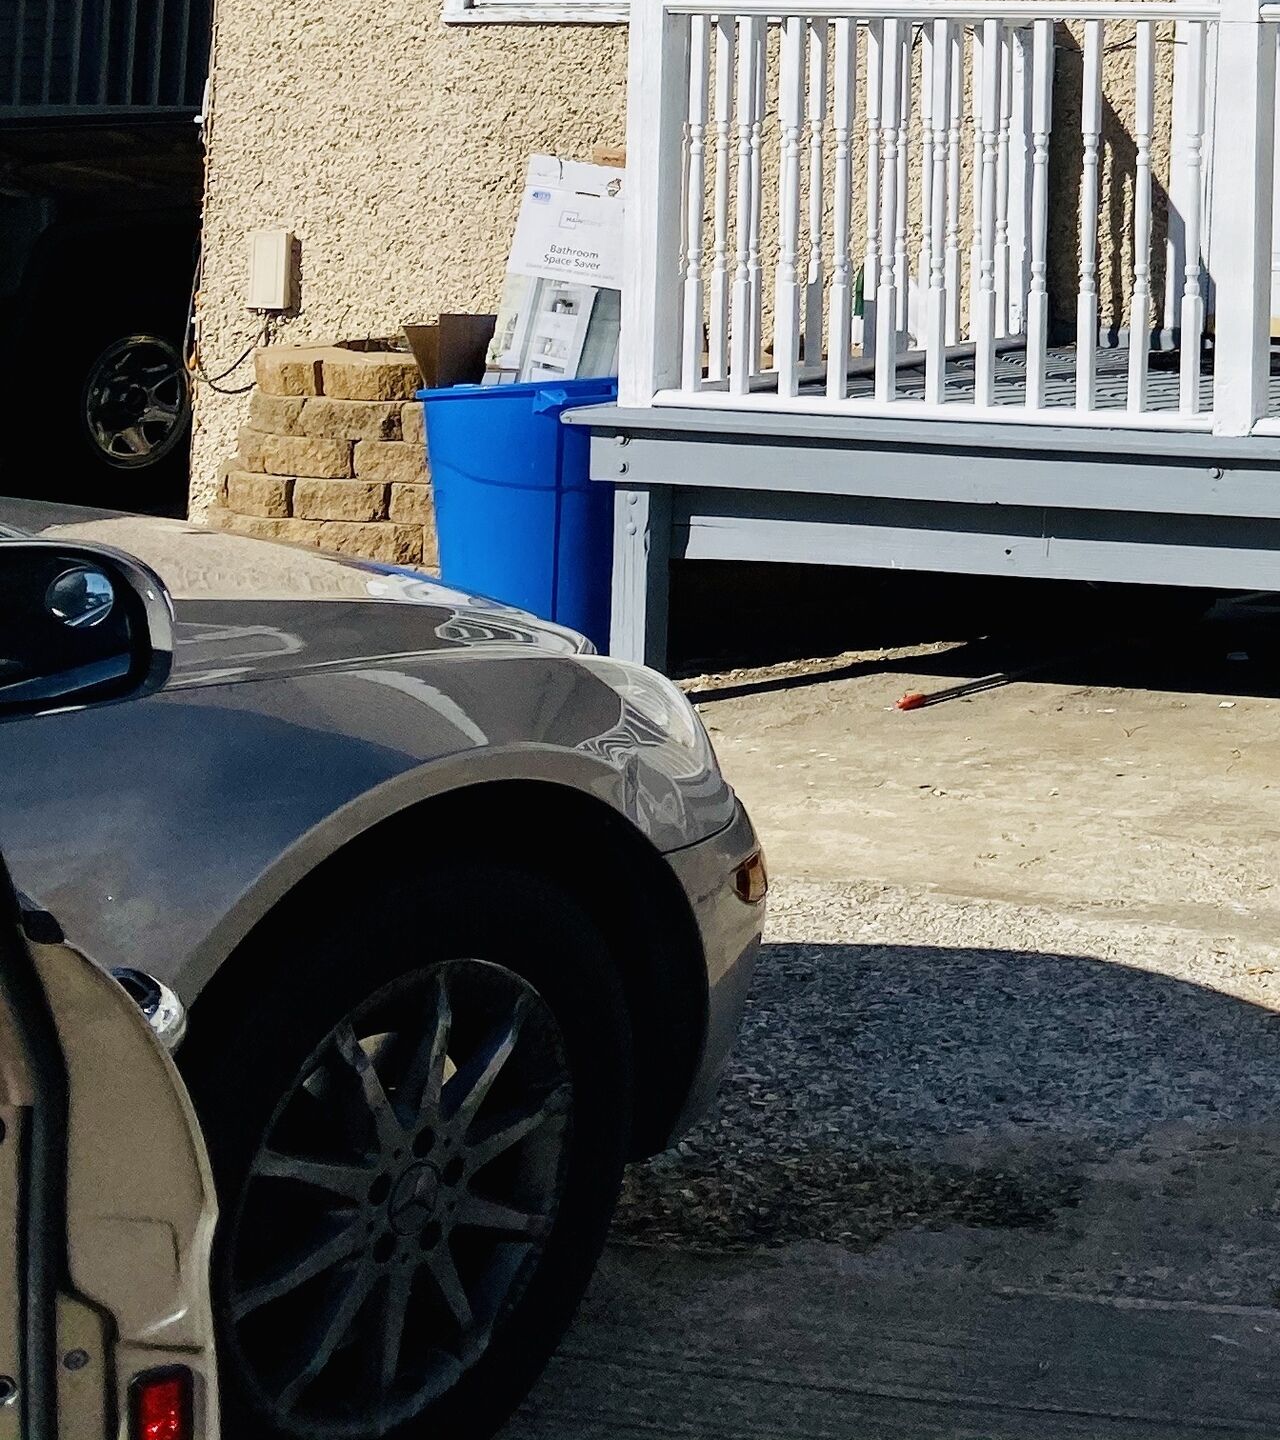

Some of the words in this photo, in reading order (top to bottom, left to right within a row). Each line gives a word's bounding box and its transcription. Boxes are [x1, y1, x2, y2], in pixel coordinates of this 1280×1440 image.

[550, 244, 599, 259] Bathroom
[543, 254, 572, 265] Space
[574, 258, 601, 270] Saver
